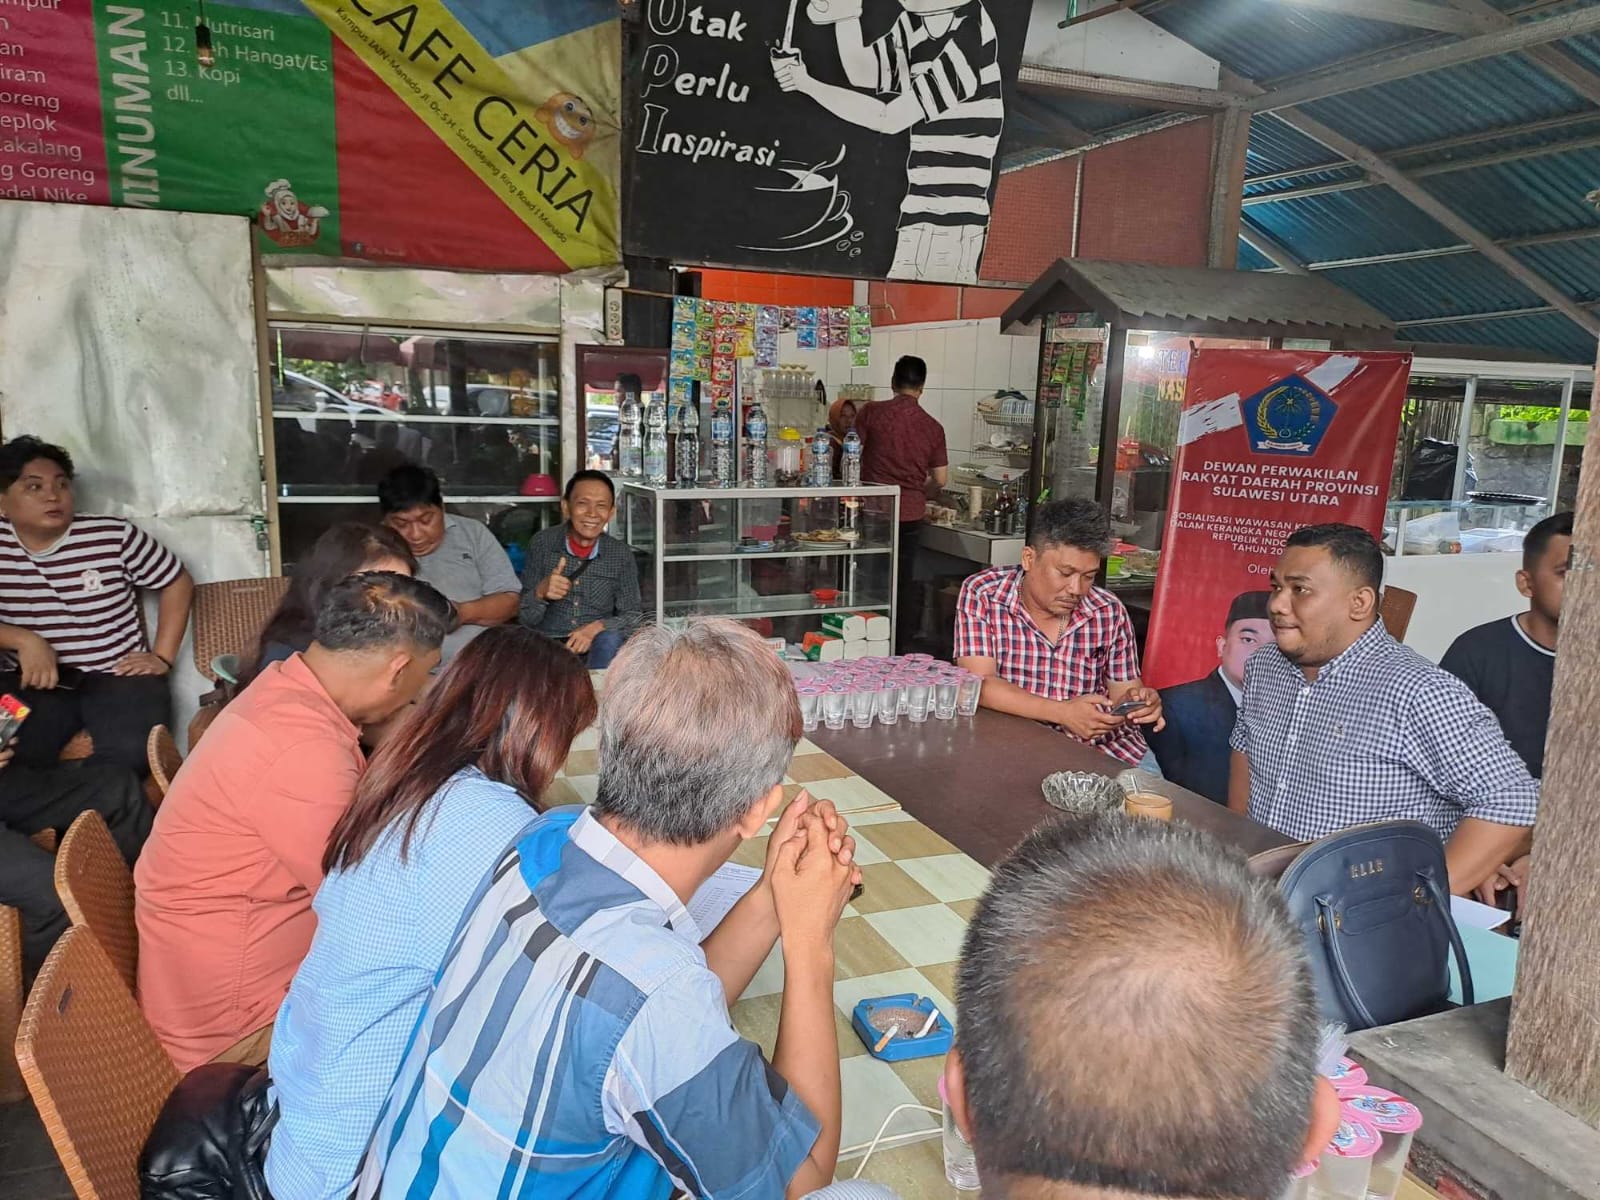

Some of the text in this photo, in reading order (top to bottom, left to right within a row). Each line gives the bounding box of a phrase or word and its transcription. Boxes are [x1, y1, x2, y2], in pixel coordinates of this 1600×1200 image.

[160, 11, 189, 30] 11.
[648, 0, 747, 42] Otak
[162, 36, 190, 53] 12.
[235, 45, 328, 72] Hangat/Es
[165, 60, 193, 78] 13.
[640, 44, 750, 103] Perlu
[0, 91, 60, 113] oreng
[167, 85, 204, 103] dll...
[336, 7, 369, 42] Kampus
[500, 172, 518, 194] Ring
[516, 190, 537, 211] Road
[538, 212, 567, 243] Manado
[635, 103, 780, 167] Inspirasi
[0, 136, 82, 162] akalang
[21, 162, 95, 186] Goreng
[474, 95, 593, 233] CERIA
[43, 187, 88, 202] Nike
[1203, 460, 1359, 481] DEWAN PERWAKILAN
[1182, 471, 1379, 496] RAKYAT DAERAH PROVINSI
[1212, 486, 1340, 507] SULAWESI UTARA
[1170, 520, 1204, 529] DALAM
[1206, 523, 1262, 536] KERANGKA
[1172, 511, 1232, 524] SOSIALISASI
[1235, 517, 1292, 530] WAWASAN
[1212, 532, 1259, 544] REPUBLIK
[1232, 543, 1268, 554] TAHUN
